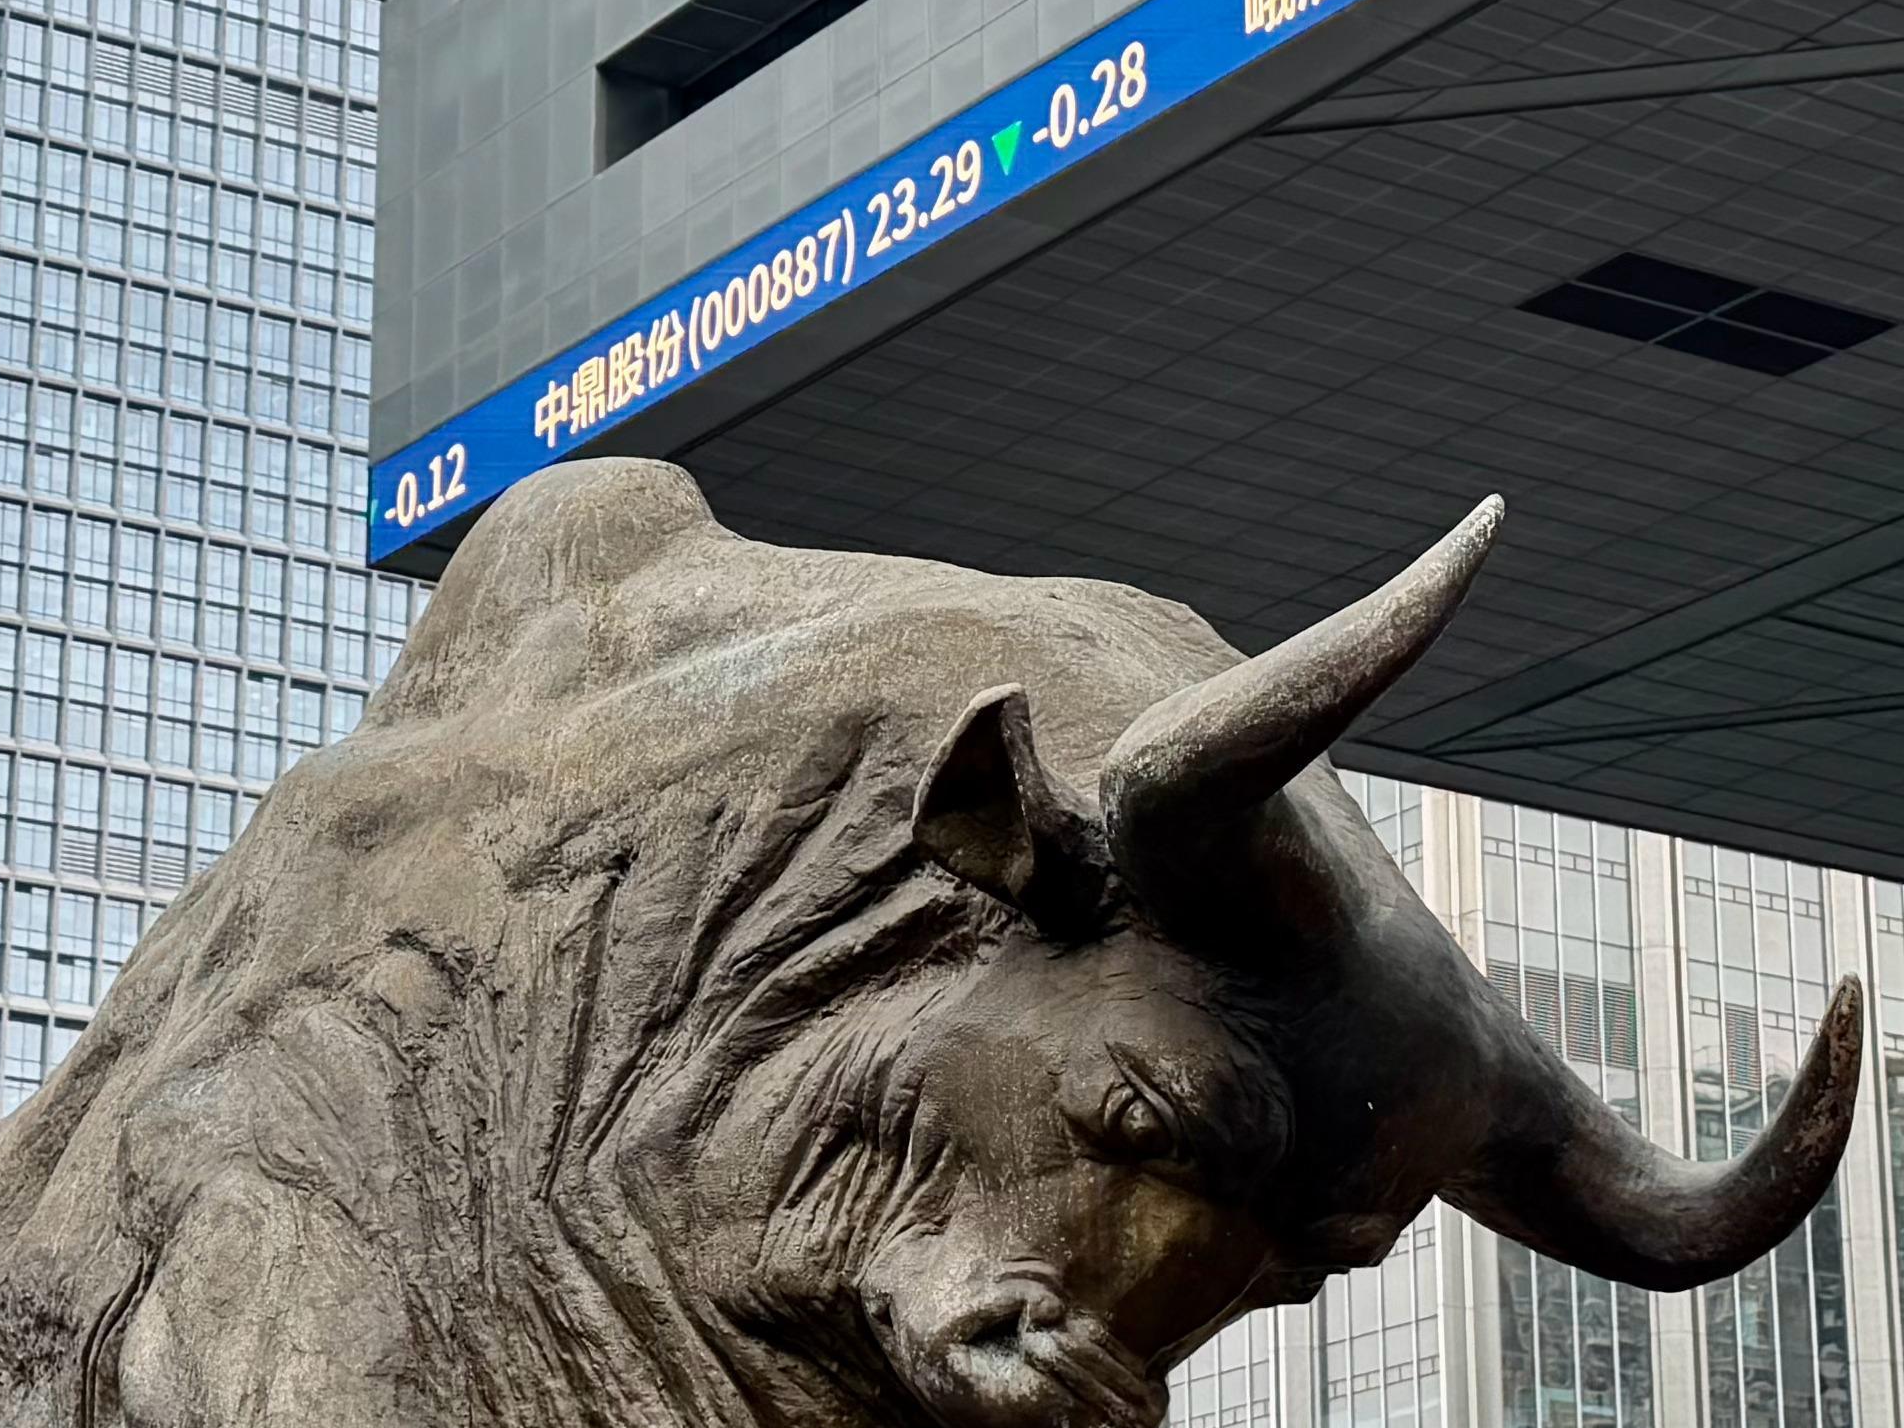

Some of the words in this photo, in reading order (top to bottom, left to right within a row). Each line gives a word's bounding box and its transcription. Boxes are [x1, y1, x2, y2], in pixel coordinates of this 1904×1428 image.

[383, 442, 467, 528] -0.12
[865, 138, 983, 258] 23.29
[1031, 40, 1148, 150] -0.28
